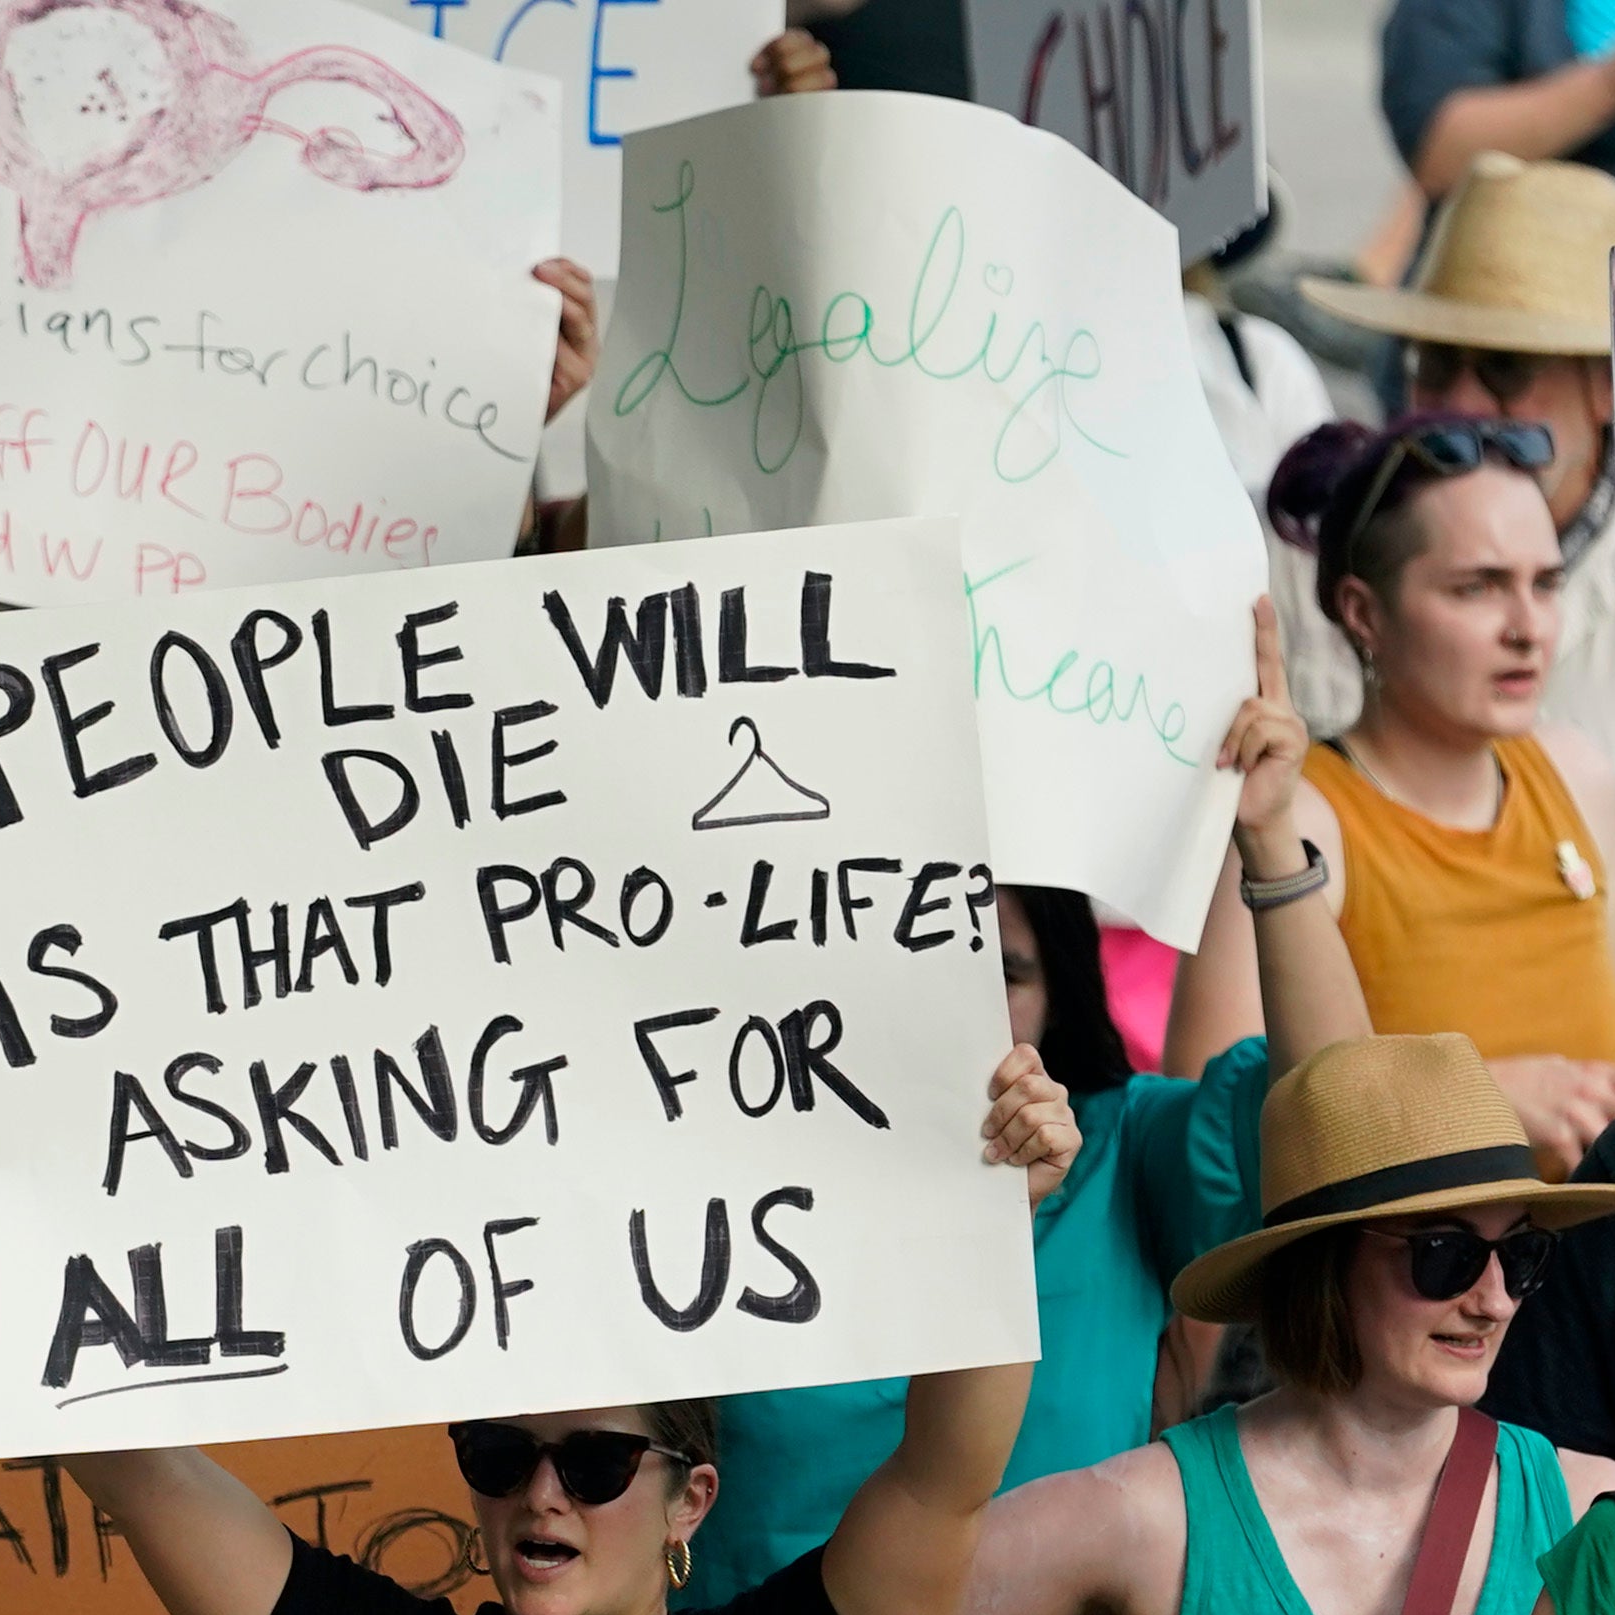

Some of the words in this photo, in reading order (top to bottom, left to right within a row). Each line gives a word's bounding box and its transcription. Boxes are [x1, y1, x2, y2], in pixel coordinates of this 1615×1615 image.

[614, 157, 1130, 484] Legalize
[301, 332, 530, 463] choice
[540, 569, 899, 709] WILL
[320, 698, 568, 852] DIE
[158, 879, 427, 1016] THAT
[101, 1012, 571, 1197] ASKING
[631, 998, 893, 1131] FOR
[41, 1223, 288, 1388] ALL
[397, 1216, 542, 1361] OF
[627, 1185, 824, 1333] US
[269, 1479, 487, 1598] TO
